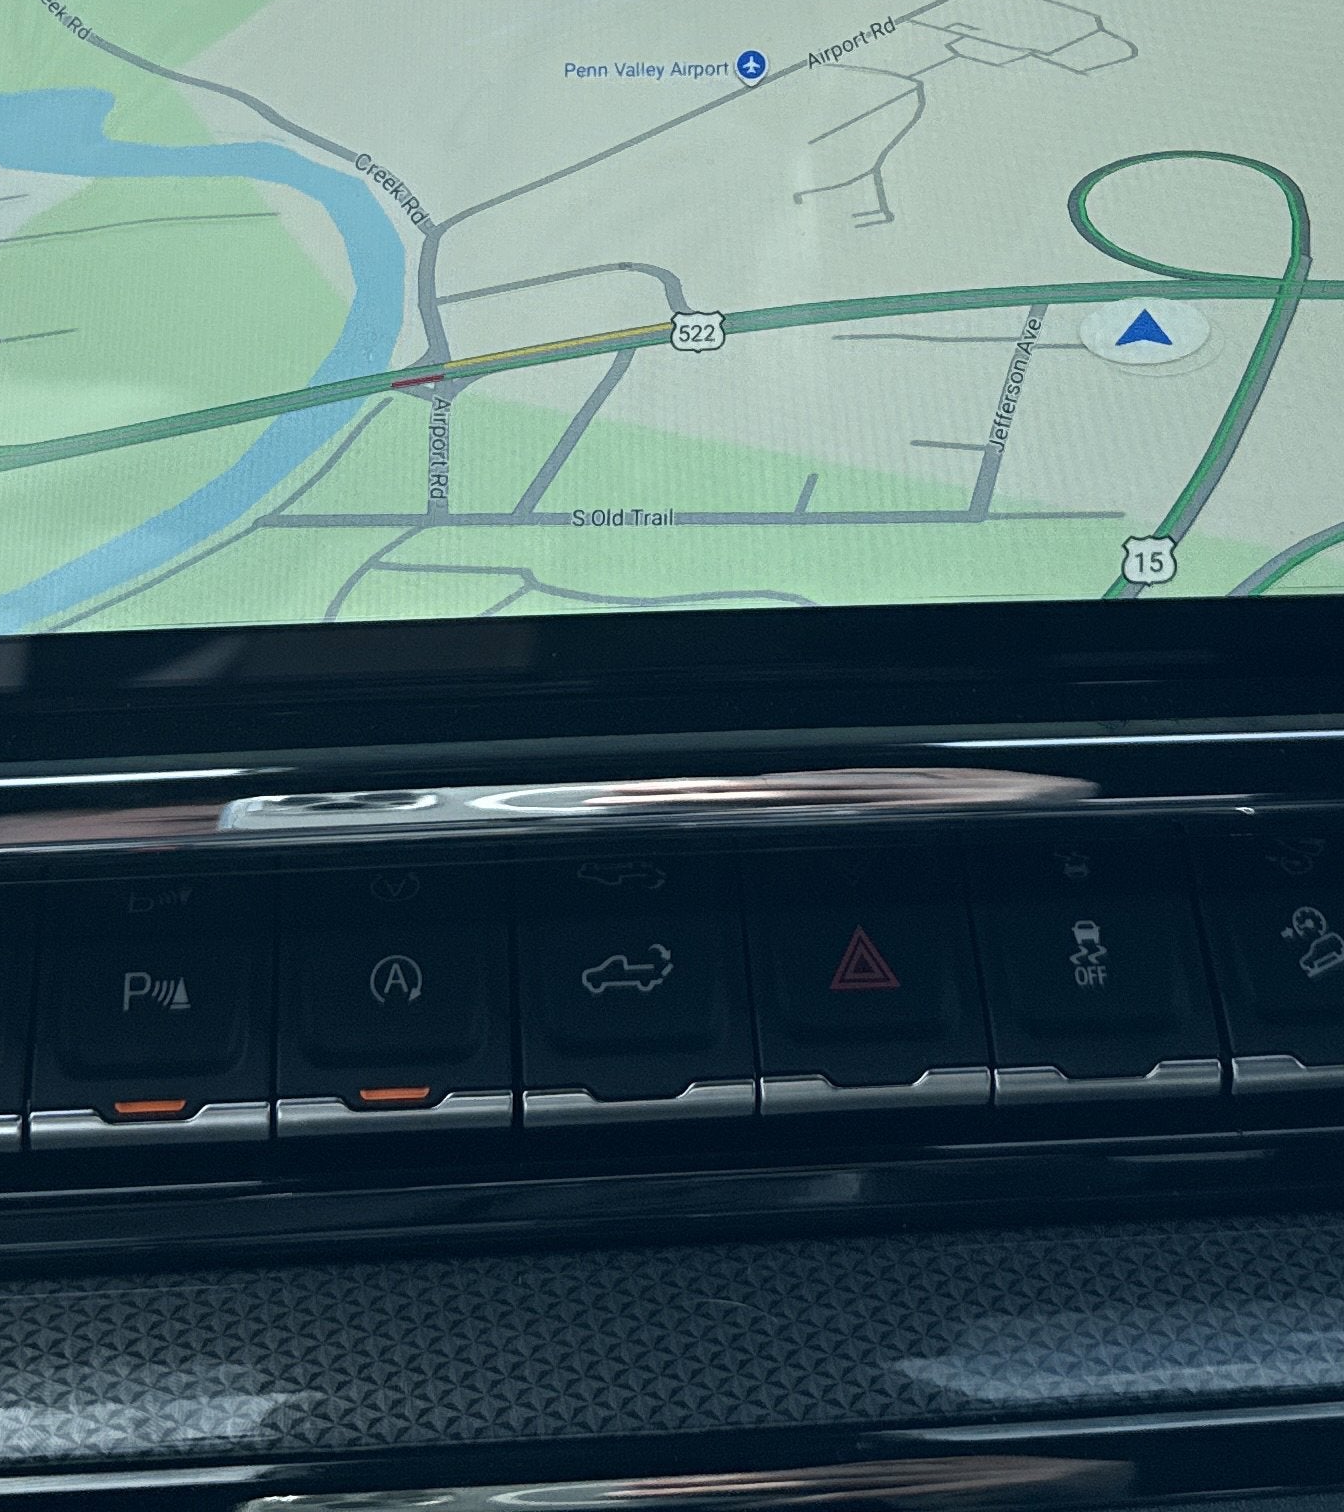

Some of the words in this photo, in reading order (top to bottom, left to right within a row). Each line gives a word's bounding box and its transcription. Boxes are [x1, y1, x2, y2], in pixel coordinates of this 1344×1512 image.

[67, 15, 93, 40] Rd
[807, 29, 868, 70] Airport
[869, 16, 898, 38] Rd
[563, 61, 609, 78] Penn
[613, 60, 666, 81] Valley
[669, 59, 730, 80] Airport
[355, 153, 405, 201] Creek
[401, 195, 430, 226] Rd
[678, 324, 716, 343] 522
[989, 356, 1028, 453] Jefferson
[1017, 317, 1043, 355] Ave
[428, 397, 452, 469] Airport
[428, 473, 449, 500] Rd
[571, 509, 586, 528] S
[590, 508, 624, 528] Old
[631, 508, 674, 527] Trail
[1134, 551, 1164, 573] 15
[1074, 965, 1108, 986] OFF
[124, 971, 152, 1011] P
